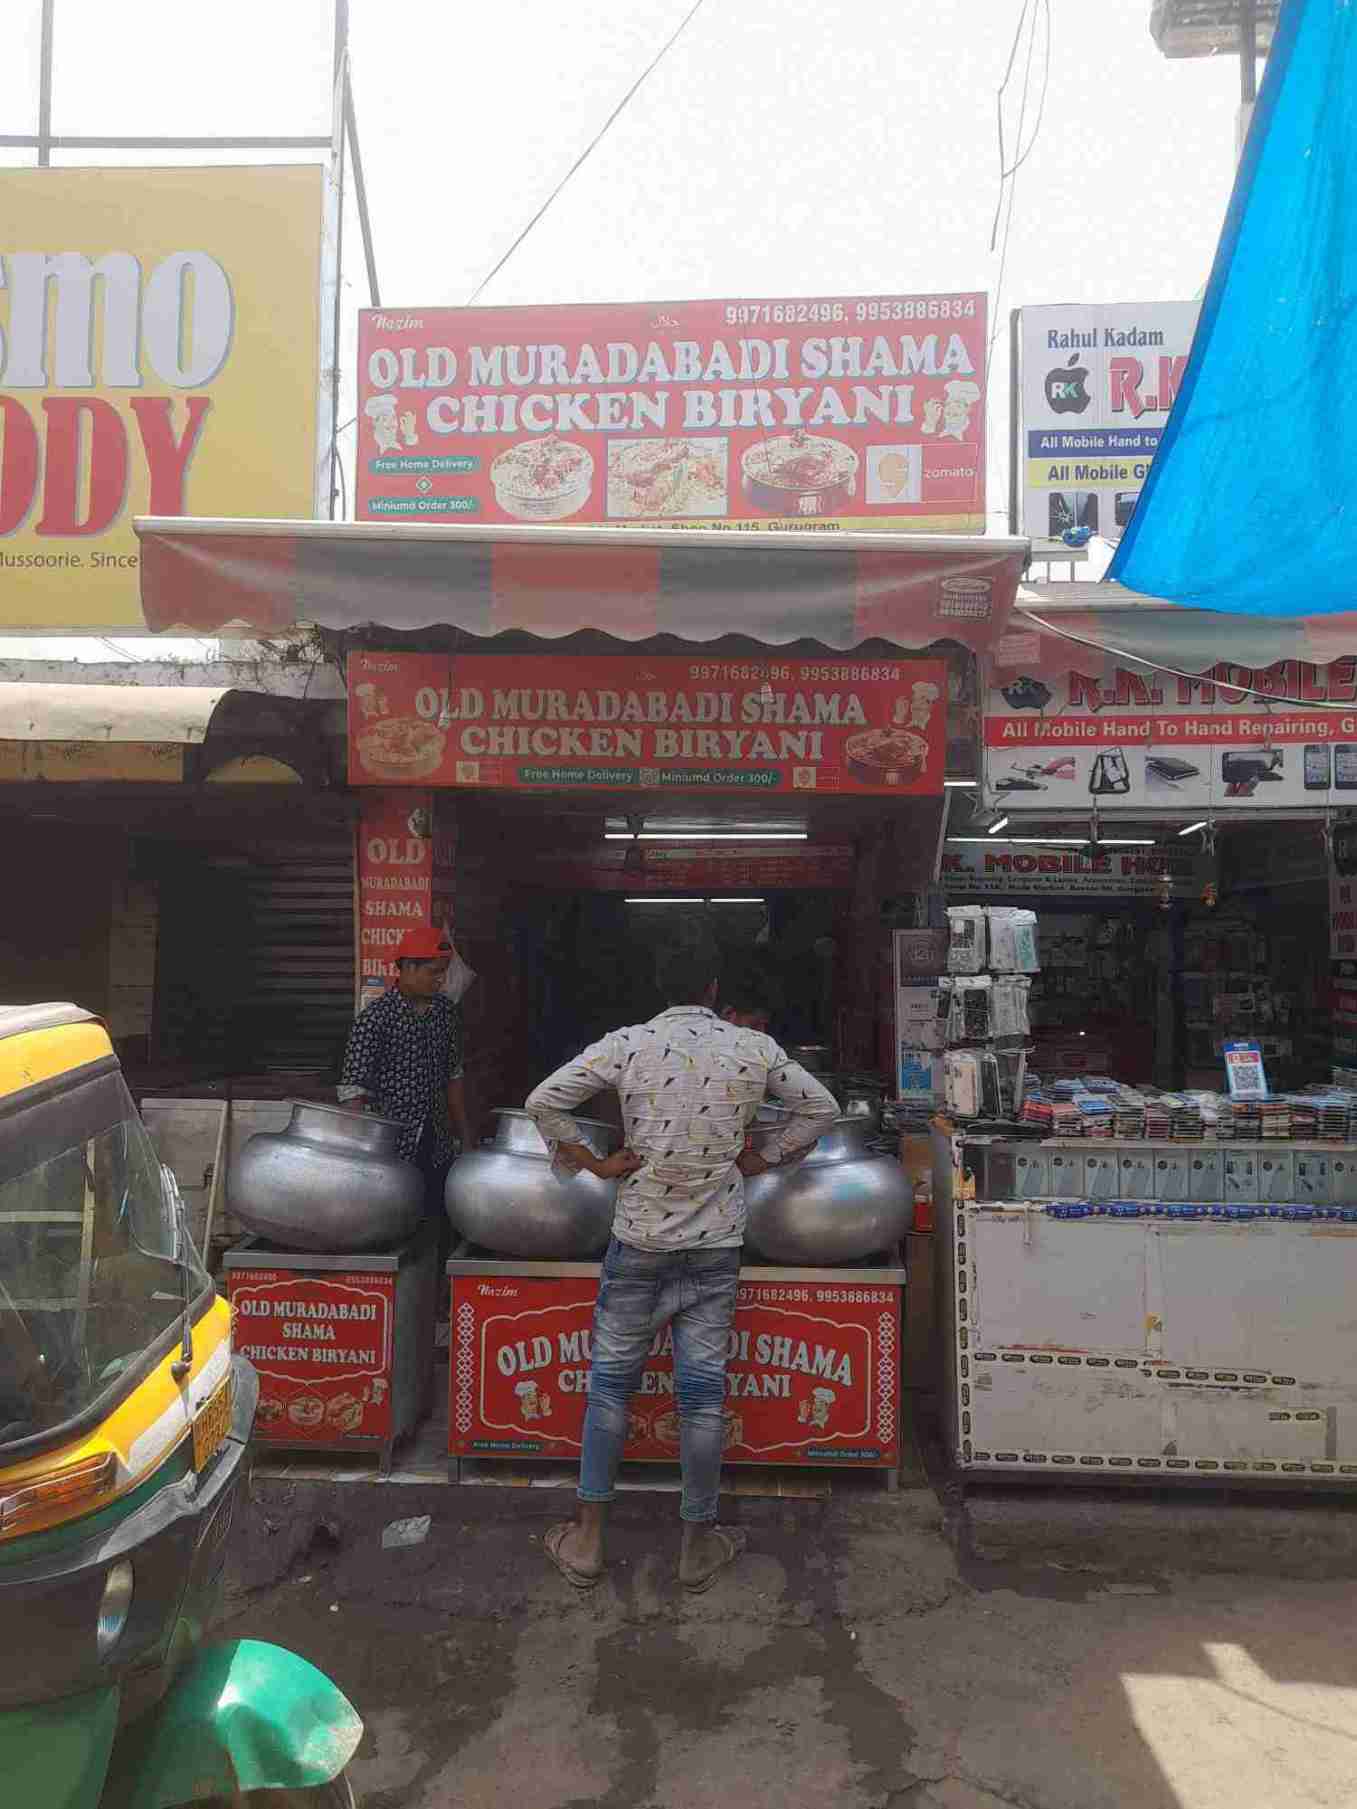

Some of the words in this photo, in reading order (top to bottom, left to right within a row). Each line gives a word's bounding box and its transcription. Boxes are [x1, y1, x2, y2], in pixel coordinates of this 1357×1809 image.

[0, 250, 234, 389] mo
[1048, 329, 1097, 348] Rahul
[1104, 327, 1164, 348] Kadam
[368, 348, 457, 389] OLD
[468, 339, 790, 386] MURADABADI
[801, 334, 976, 379] SHAMA
[1051, 382, 1080, 400] RK
[426, 391, 669, 434] CHICKEN
[683, 384, 914, 428] BIRYANI
[1041, 436, 1058, 449] All
[1062, 435, 1104, 449] Mobile
[1108, 435, 1141, 448] Hand
[1145, 435, 1158, 446] to
[400, 460, 429, 470] Home
[432, 459, 473, 473] Delivery
[923, 467, 976, 480] zomato
[1048, 465, 1069, 480] All
[1075, 464, 1128, 480] Mobile
[90, 551, 138, 568] Since
[415, 687, 485, 720] OLD
[492, 688, 733, 722] MURADABADI
[741, 692, 868, 724] SHAMA
[1003, 722, 1028, 737] All
[1035, 721, 1096, 737] Mobile
[1104, 720, 1150, 737] Hand
[1158, 720, 1178, 735] To
[1184, 719, 1233, 735] Hand
[1239, 718, 1335, 738] Repairing,
[460, 726, 642, 757] CHICKEN
[653, 729, 824, 760] BIRYANI
[523, 768, 548, 780] Free
[552, 769, 583, 781] Home
[586, 769, 633, 784] Delivery
[367, 837, 425, 865] OLD
[366, 899, 423, 917] SHAMA
[240, 1300, 269, 1316] OLD
[273, 1301, 377, 1320] MURADABADI
[282, 1323, 336, 1340] SHAMA
[240, 1345, 309, 1361] CHICKEN
[312, 1348, 376, 1364] BIRYANI
[497, 1336, 552, 1377] OLD
[755, 1332, 853, 1387] SHAMA
